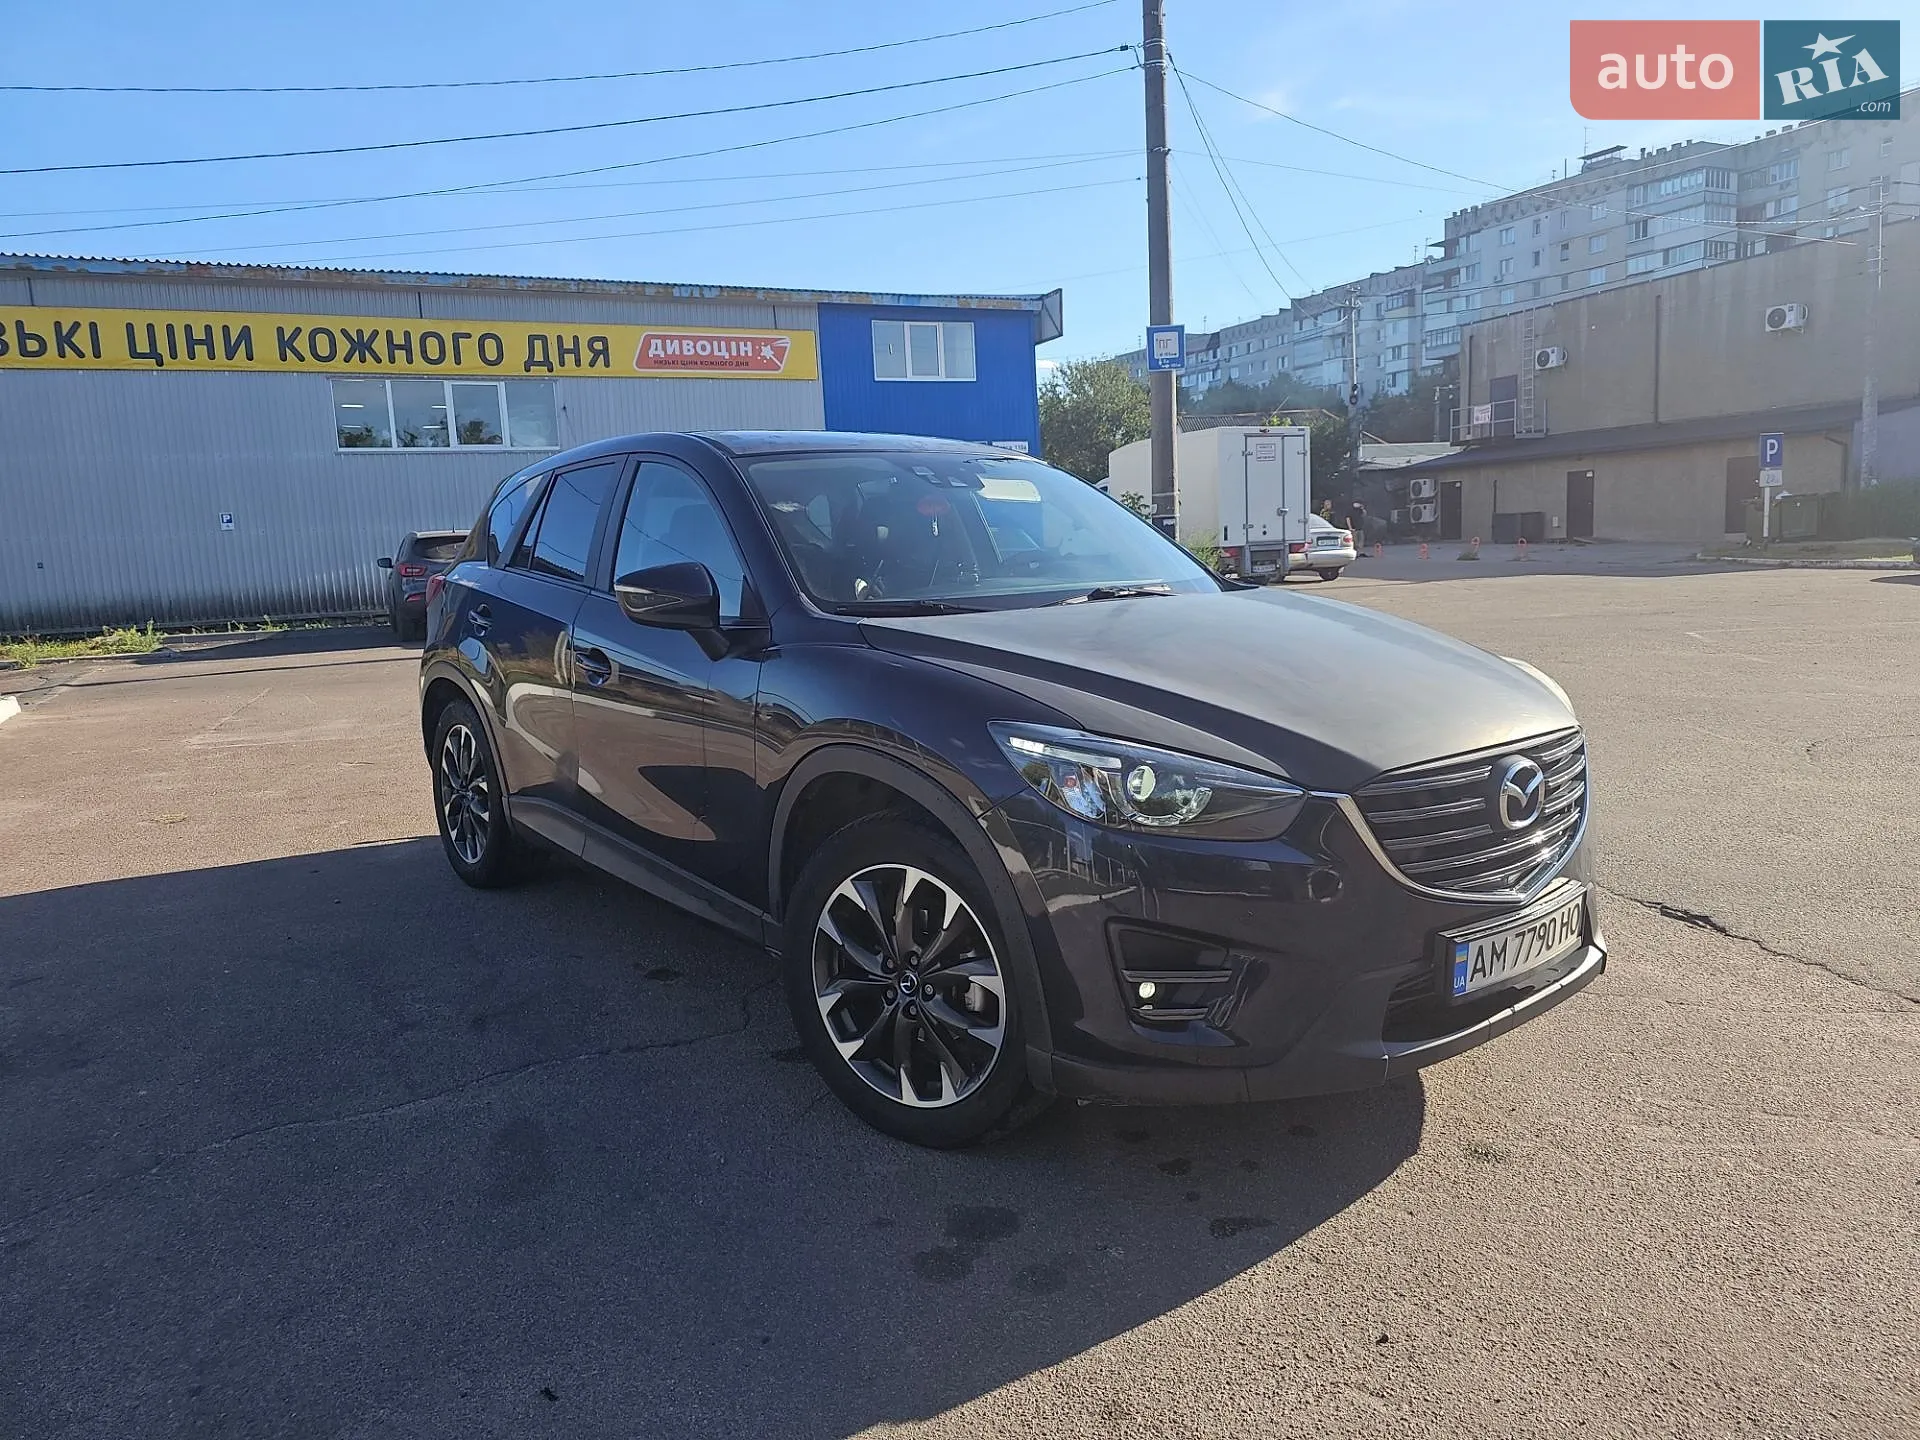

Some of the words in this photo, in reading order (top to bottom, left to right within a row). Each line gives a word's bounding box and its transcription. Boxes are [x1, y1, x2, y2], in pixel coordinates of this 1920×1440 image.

[125, 321, 254, 367] ЦІНИ
[276, 325, 505, 367] КОЖНОГО
[523, 333, 611, 373] ДНЯ
[648, 339, 753, 359] ДИВОЦІН
[1766, 438, 1779, 463] P
[1469, 936, 1509, 983] AM
[1512, 917, 1557, 968] 7790
[1453, 976, 1465, 989] UA
